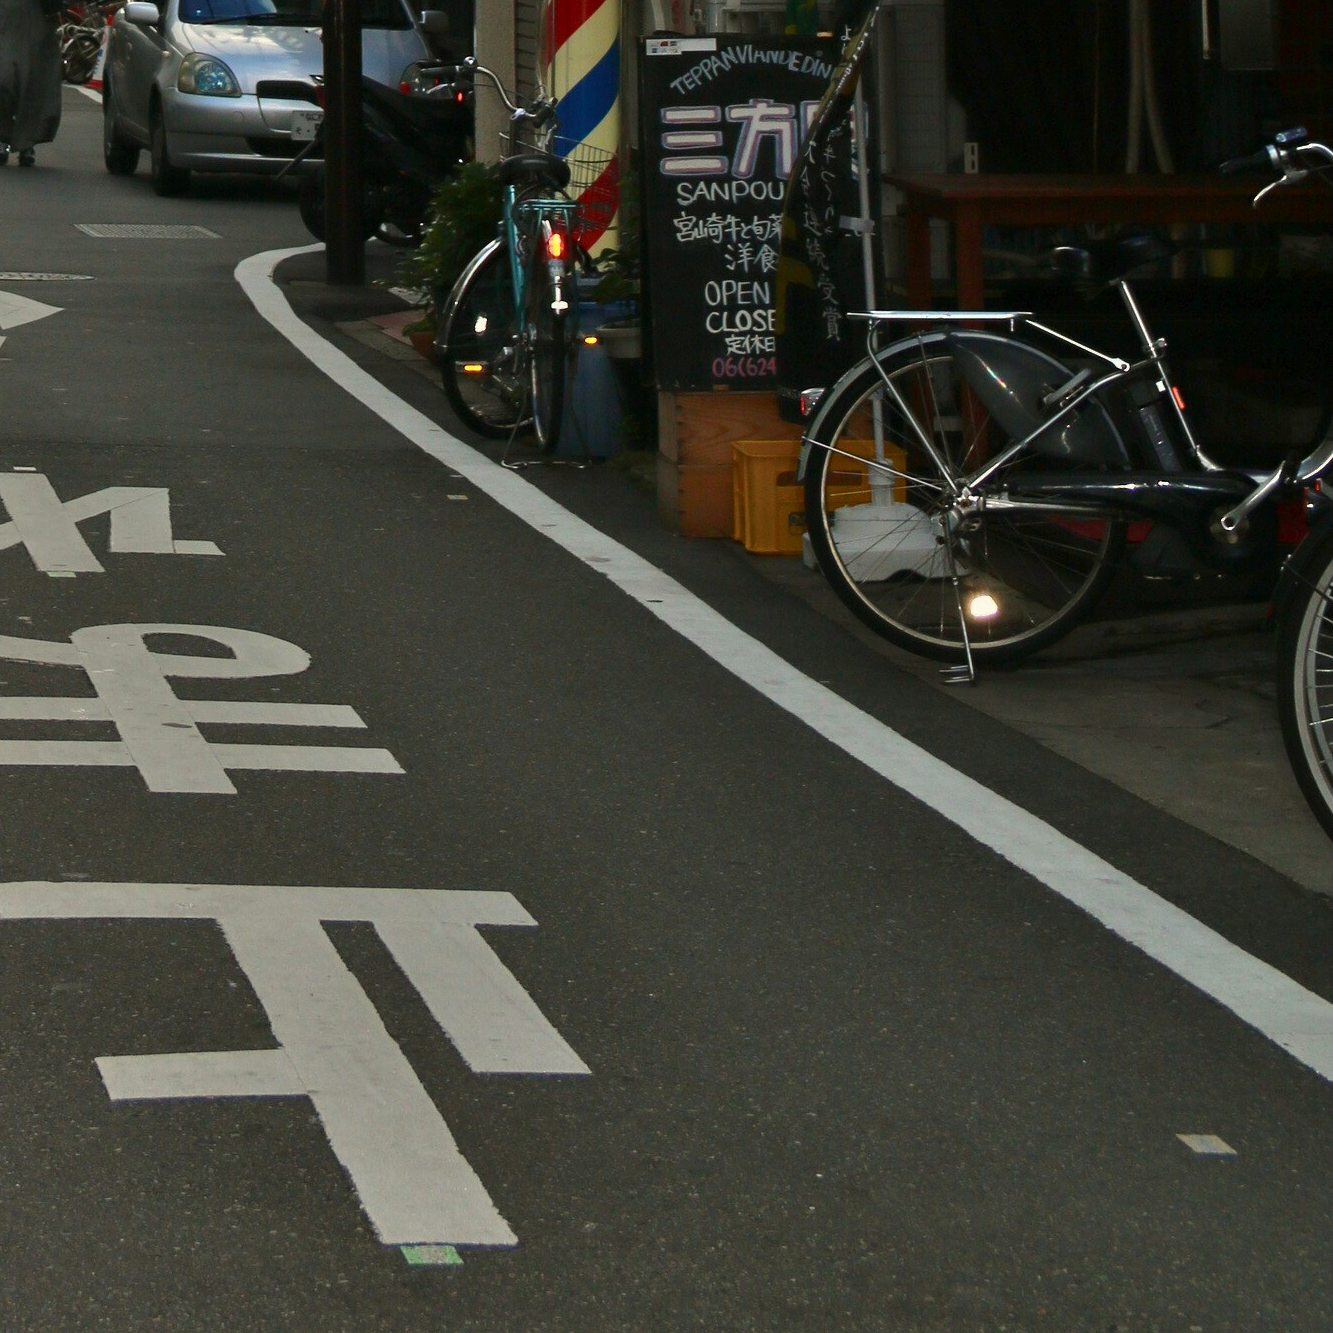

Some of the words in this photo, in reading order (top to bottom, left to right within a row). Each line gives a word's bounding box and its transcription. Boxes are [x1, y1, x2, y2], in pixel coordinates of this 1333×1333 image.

[676, 180, 785, 207] SANPOU
[724, 241, 779, 274] 洋食
[704, 280, 770, 307] OPEN
[724, 333, 777, 356] 定休日
